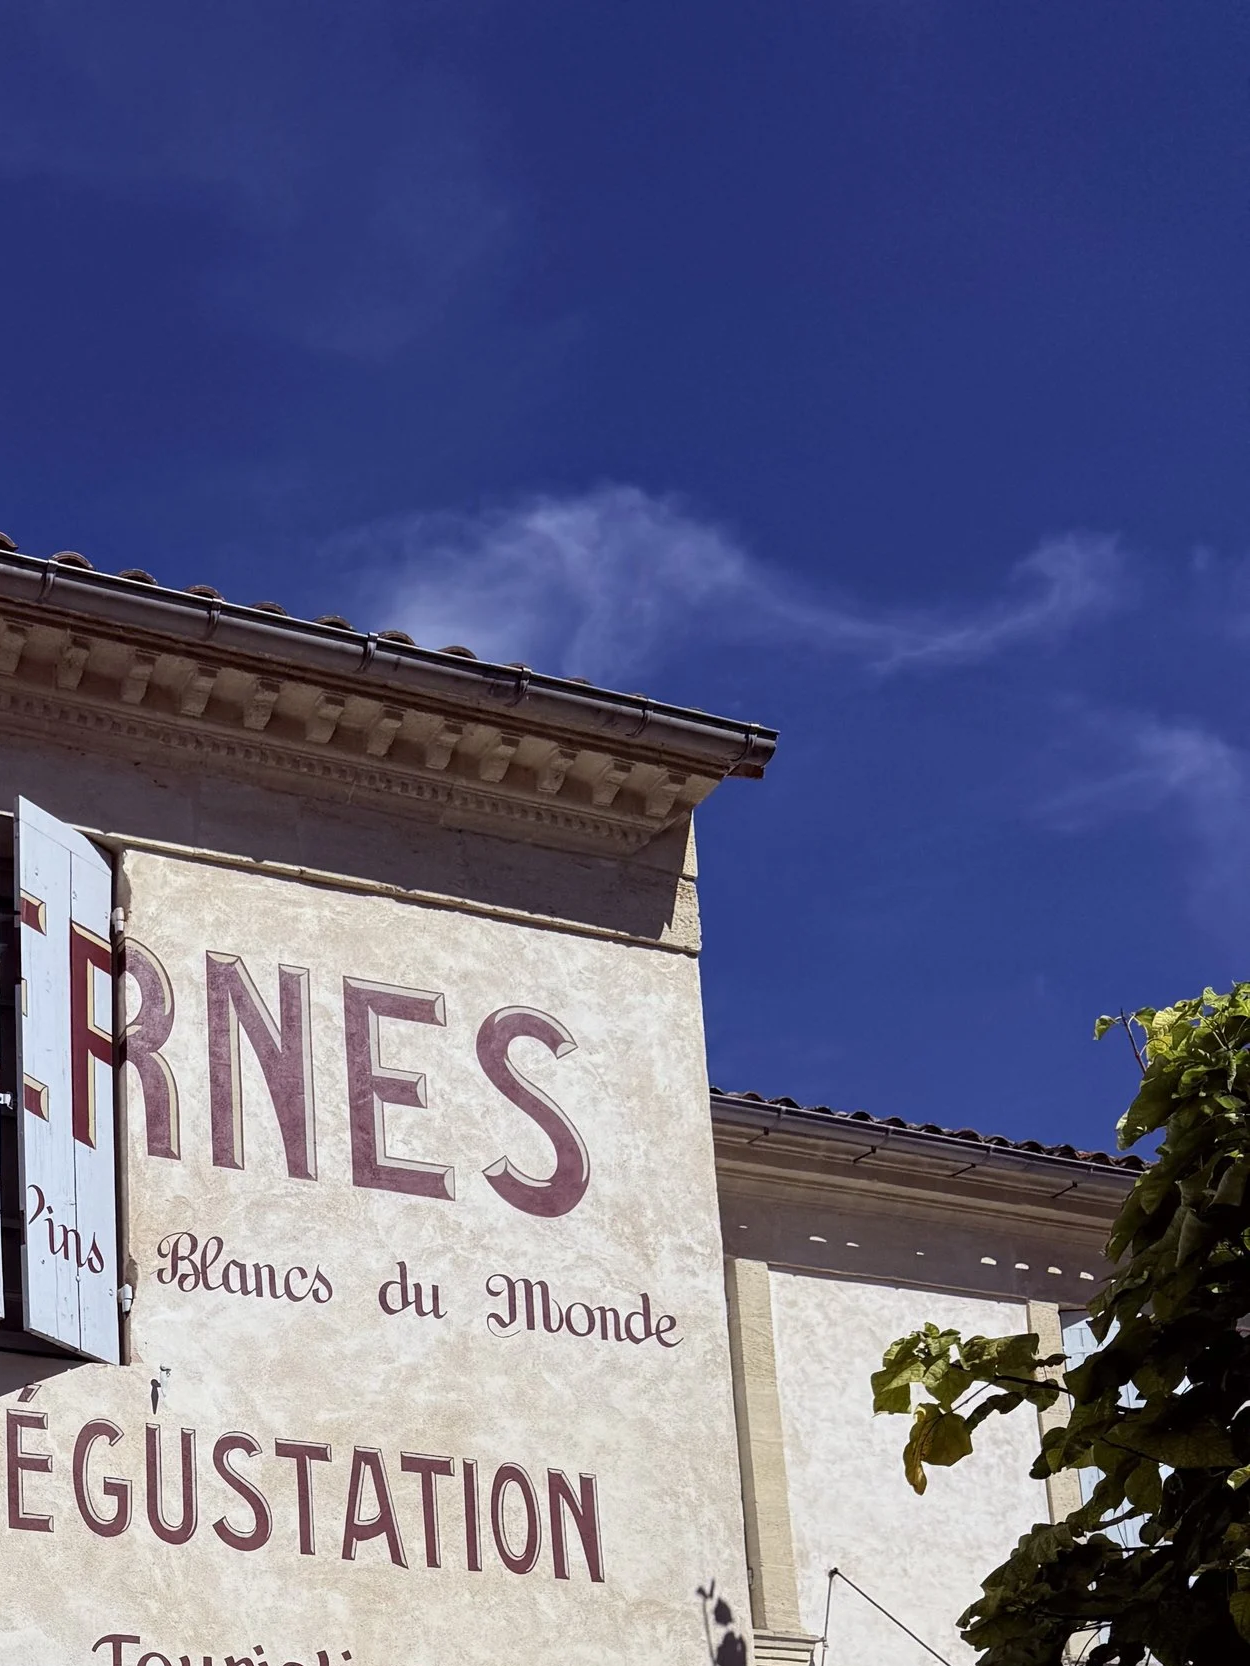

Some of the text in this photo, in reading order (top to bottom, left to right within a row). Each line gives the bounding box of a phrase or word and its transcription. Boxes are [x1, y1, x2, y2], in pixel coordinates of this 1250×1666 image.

[152, 1231, 334, 1304] Blancs
[379, 1262, 447, 1319] du
[486, 1273, 683, 1349] Monde
